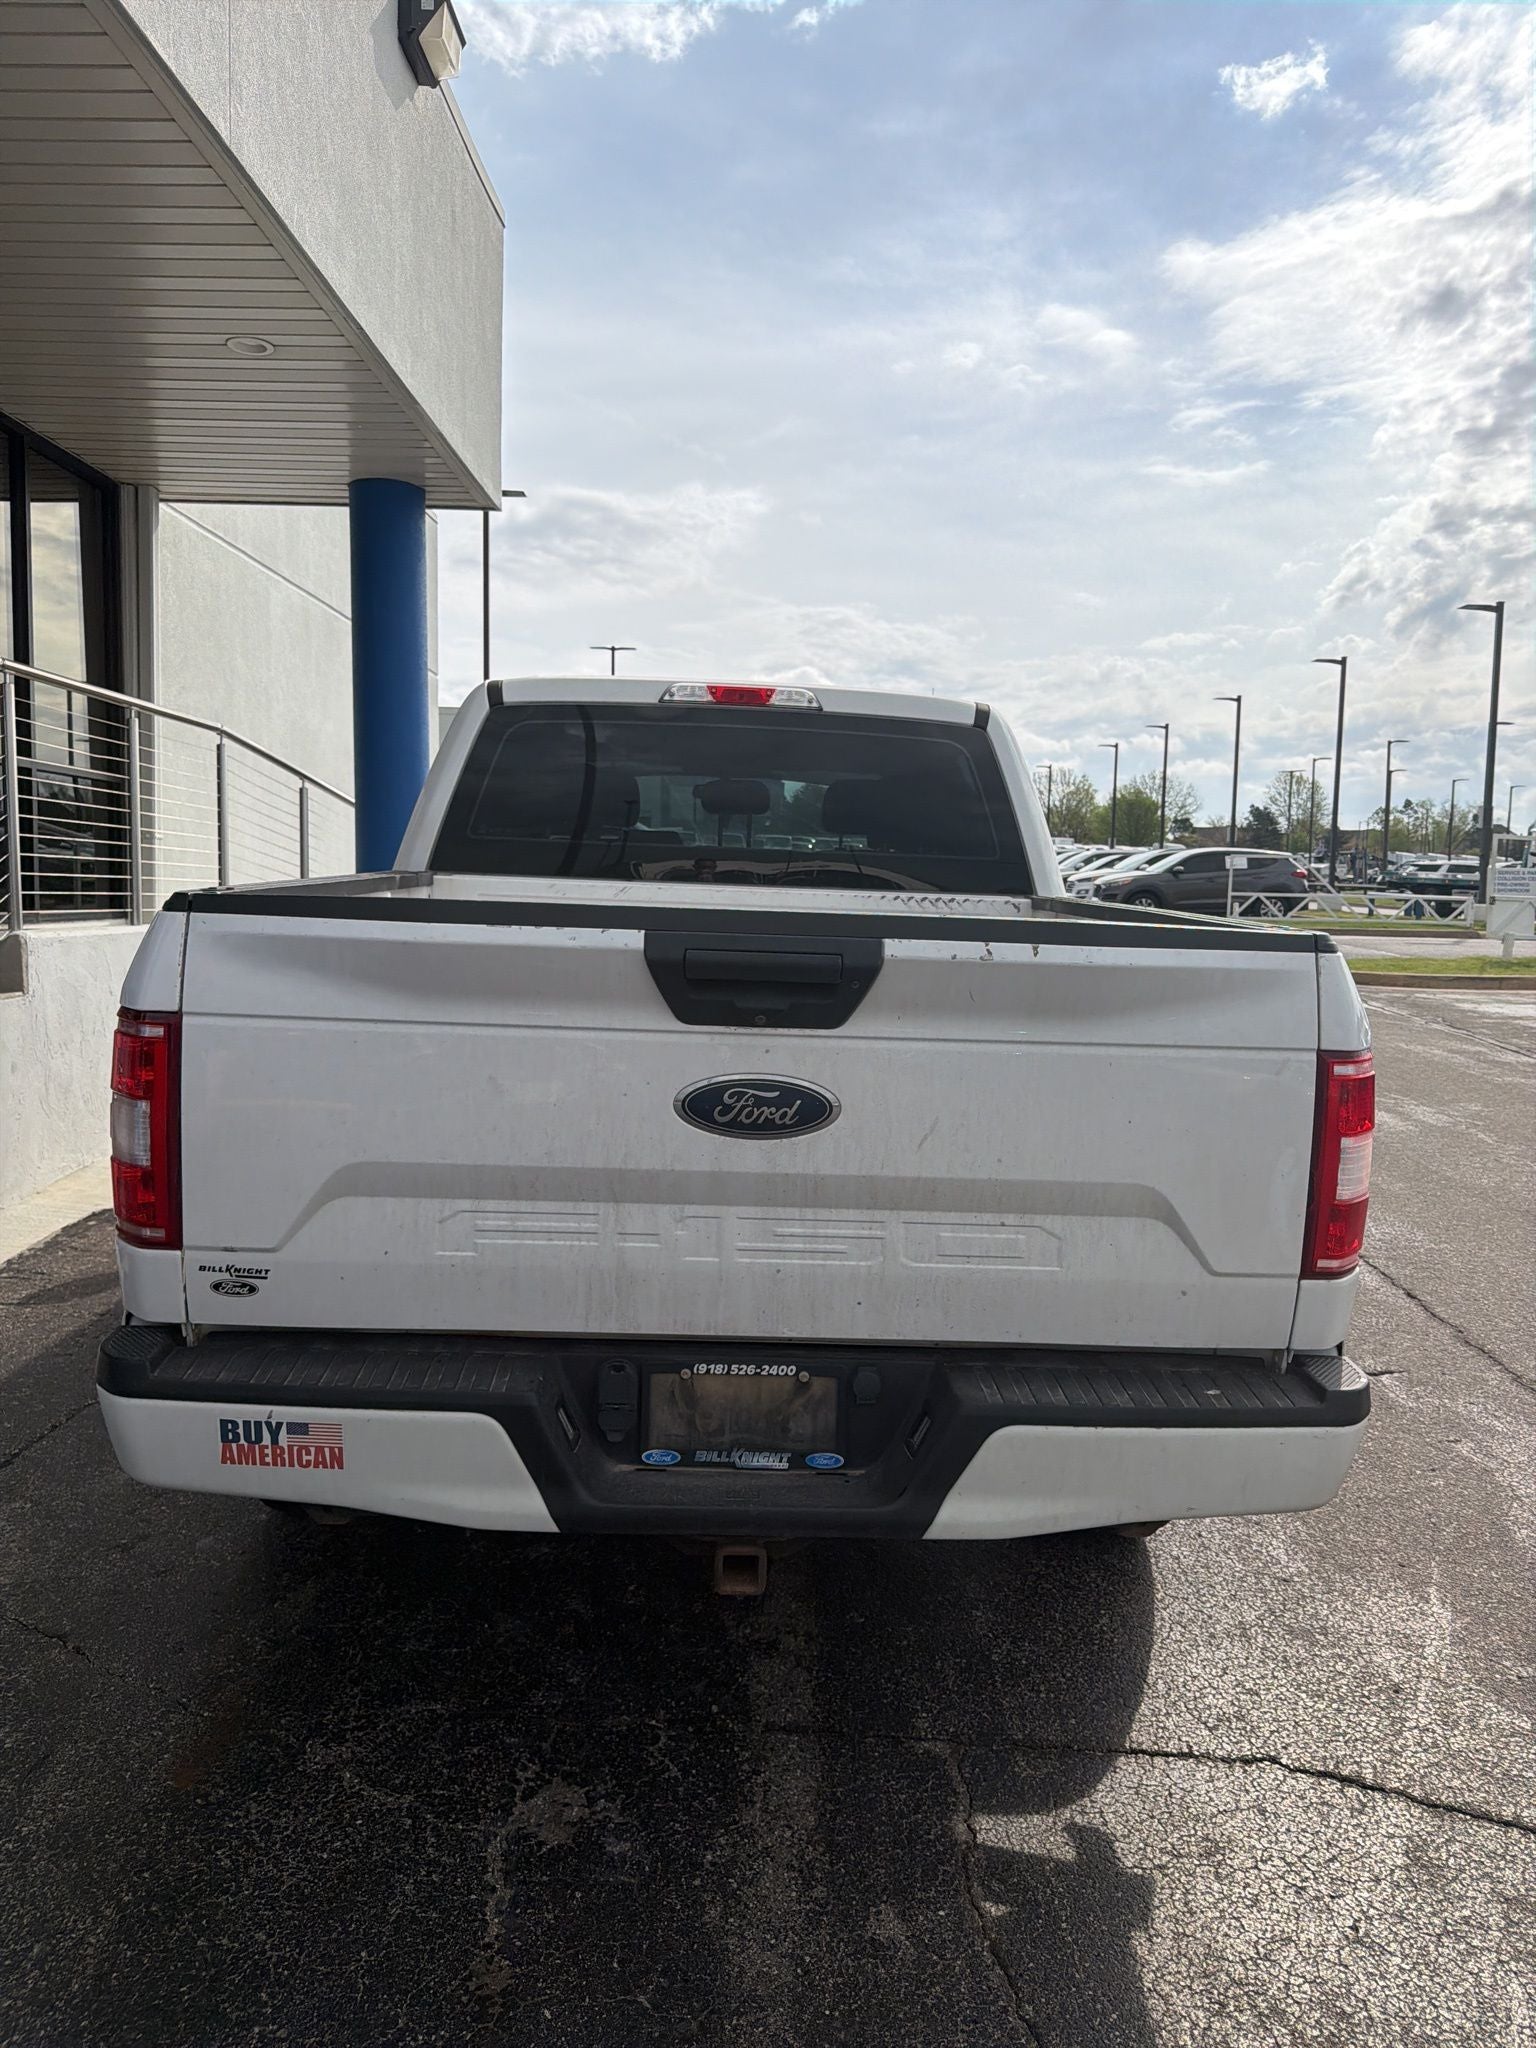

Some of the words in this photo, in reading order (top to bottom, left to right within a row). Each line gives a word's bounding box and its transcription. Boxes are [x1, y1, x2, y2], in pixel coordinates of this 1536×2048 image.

[713, 1087, 802, 1125] Ford
[434, 1209, 1064, 1271] F-150
[693, 1363, 728, 1374] (918)
[729, 1364, 797, 1376] 526-2400
[219, 1418, 285, 1446] BUY
[220, 1443, 345, 1470] AMERICAN
